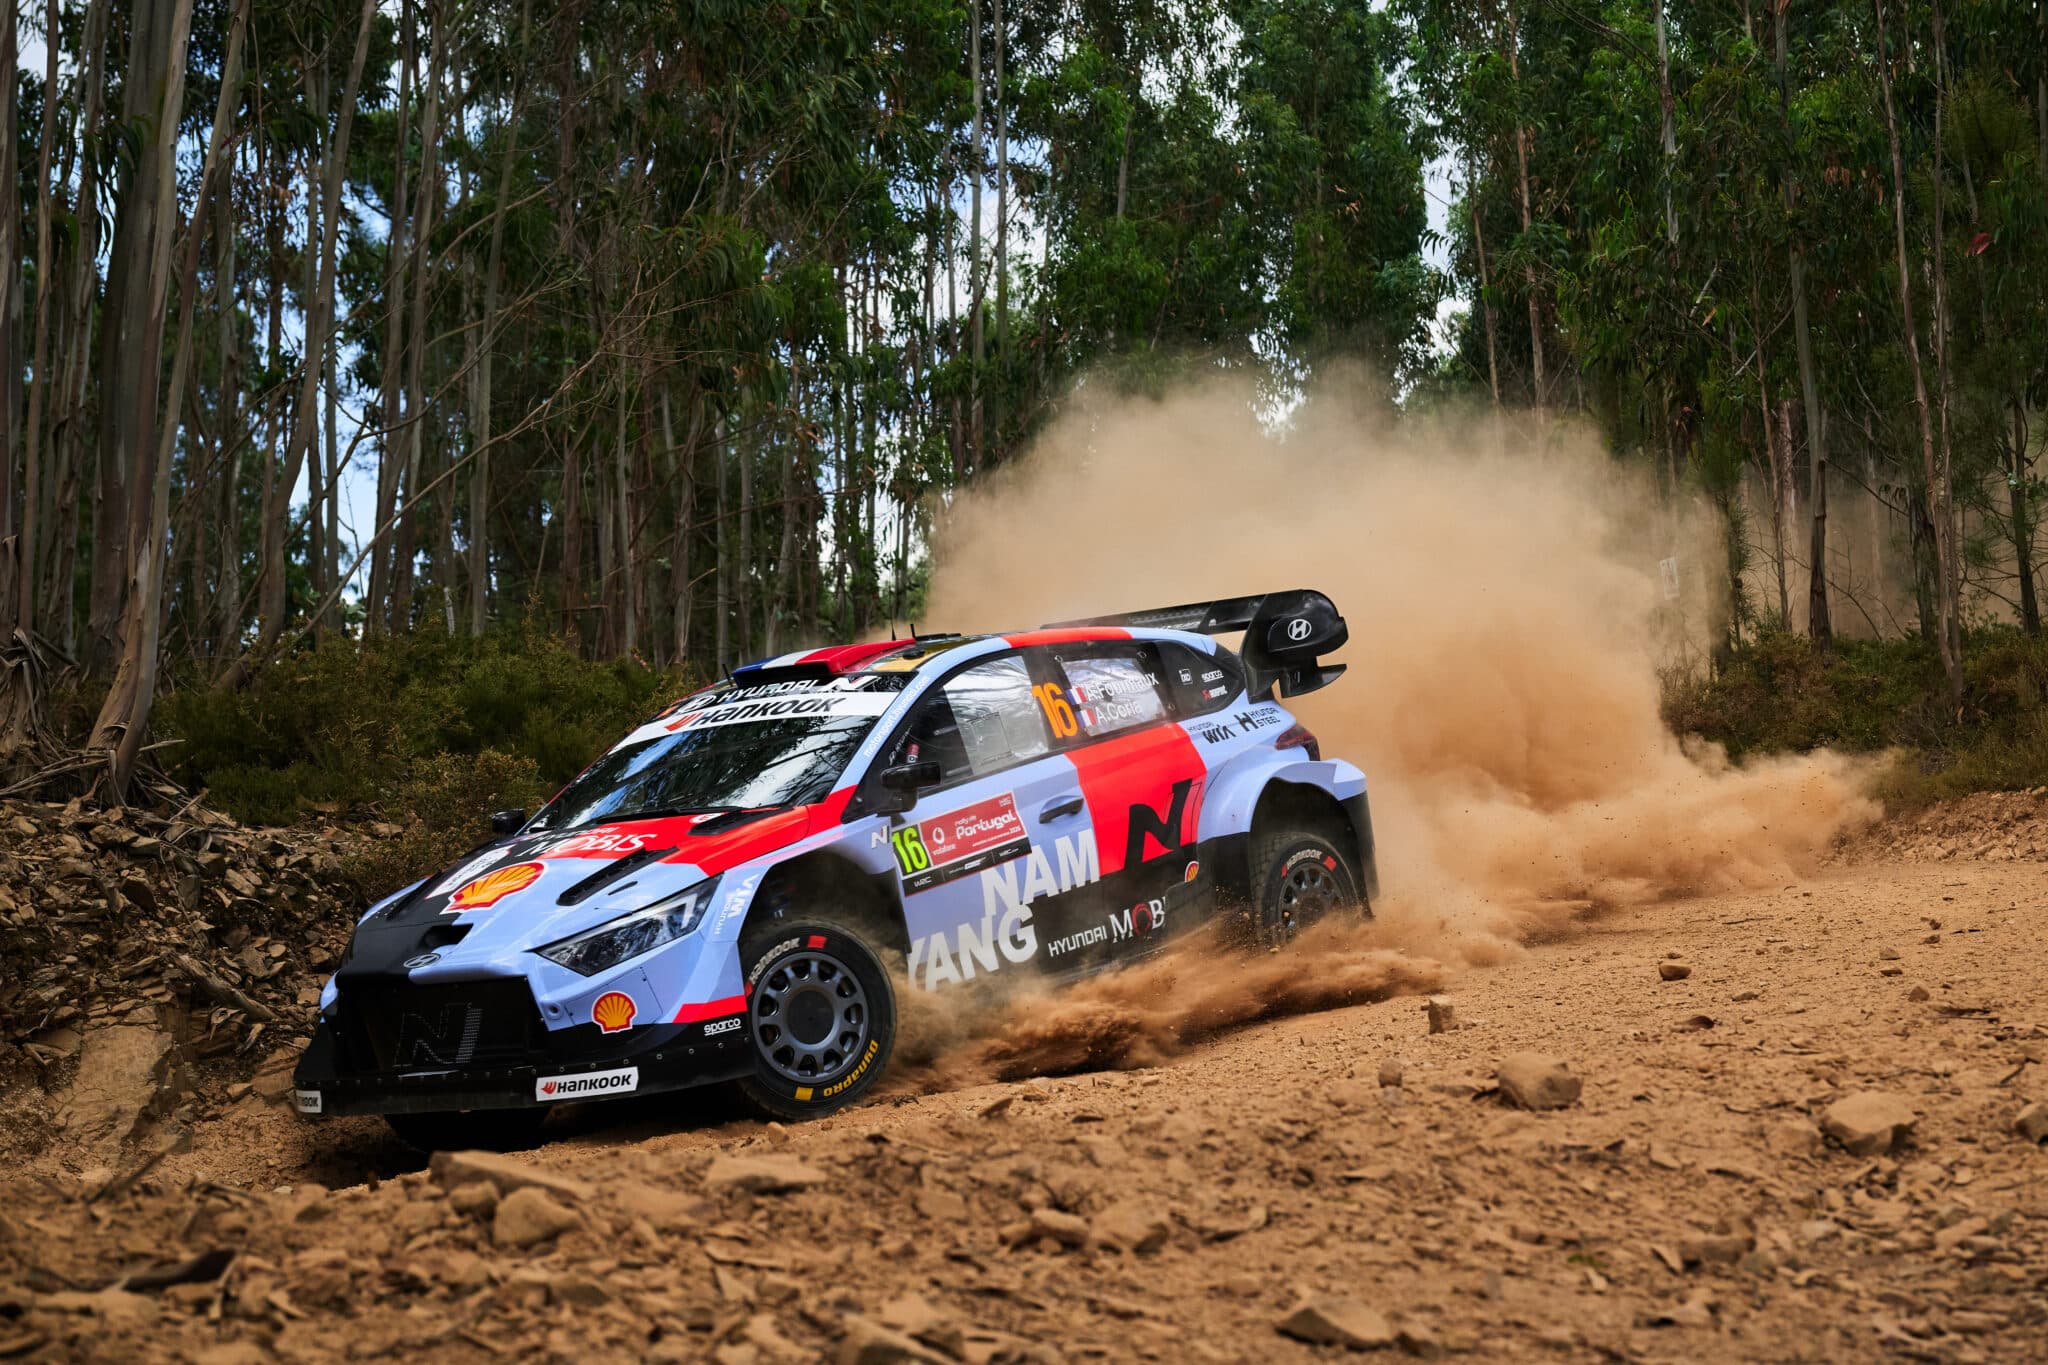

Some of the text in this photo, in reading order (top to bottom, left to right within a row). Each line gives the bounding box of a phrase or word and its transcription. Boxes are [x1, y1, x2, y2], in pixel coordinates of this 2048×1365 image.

[718, 679, 819, 703] HYUNDAI
[1032, 682, 1079, 738] 16
[1256, 717, 1281, 727] STEEL
[956, 809, 1017, 839] Portugal
[514, 833, 658, 858] MOBIS
[892, 826, 928, 874] 16
[980, 828, 1100, 917] NAM
[1048, 925, 1108, 958] HYUNDAI
[704, 1017, 742, 1036] sparco
[557, 1073, 633, 1094] HANKOOK
